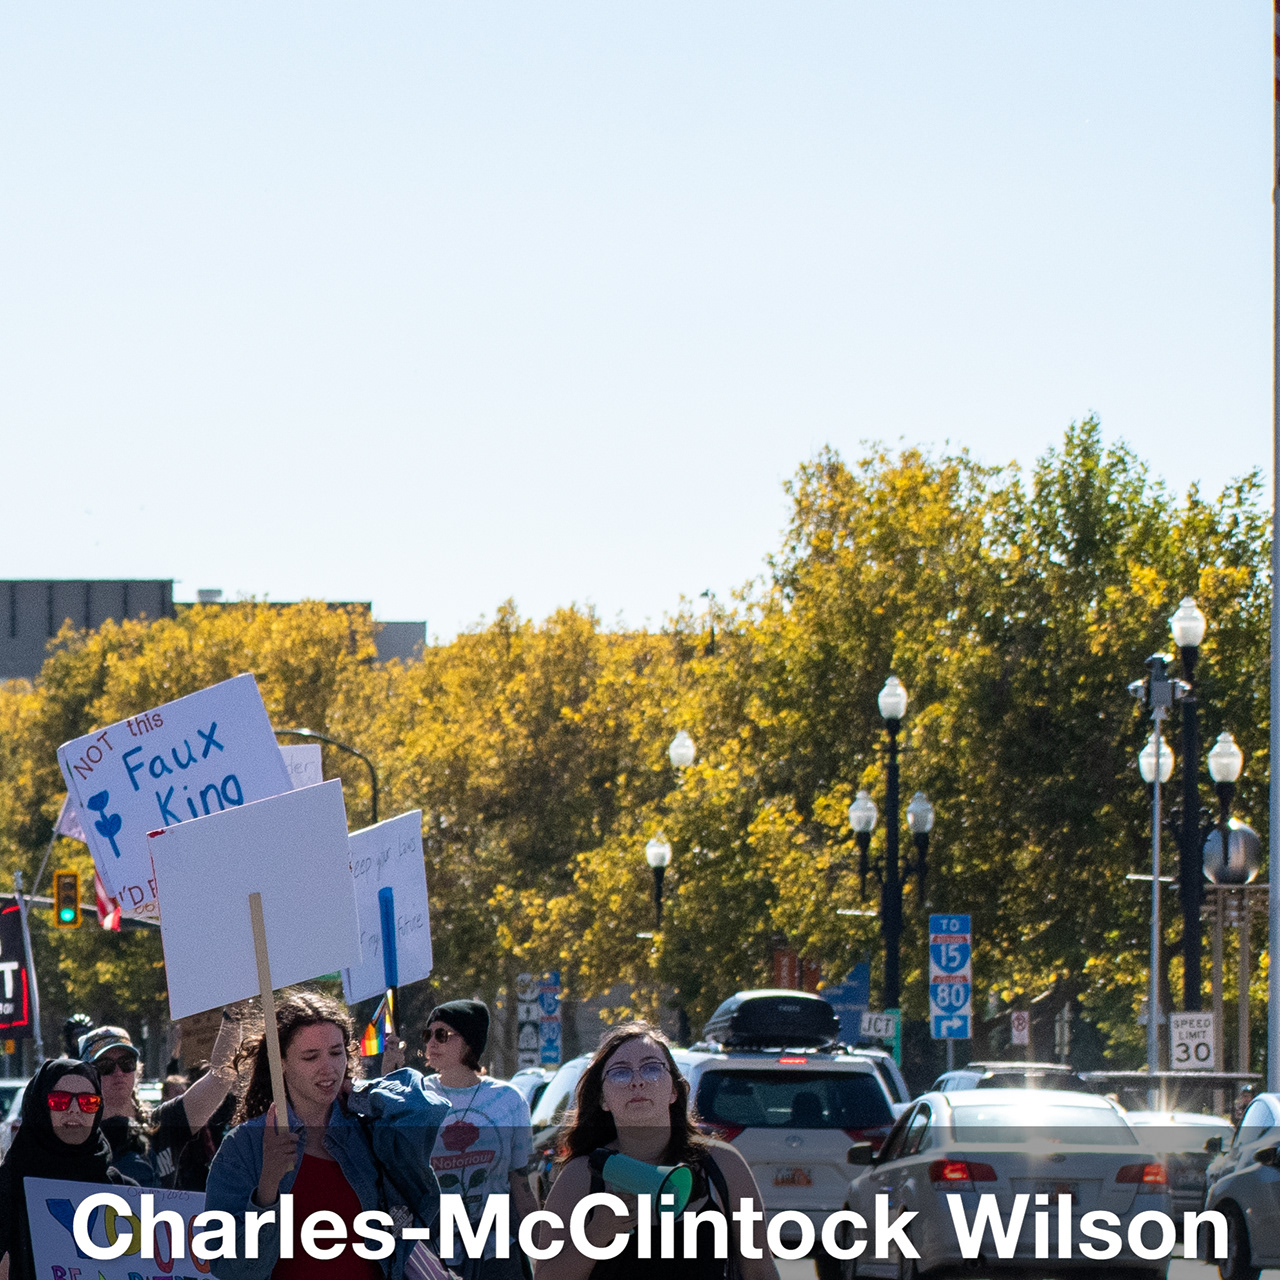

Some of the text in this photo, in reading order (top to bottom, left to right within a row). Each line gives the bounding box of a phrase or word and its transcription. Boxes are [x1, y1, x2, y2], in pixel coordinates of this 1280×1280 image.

[73, 713, 164, 780] NOT this
[122, 721, 224, 791] Faux
[941, 919, 960, 931] TO
[940, 944, 961, 967] 15
[937, 985, 965, 1007] 80
[864, 1018, 891, 1034] JCT
[1173, 1019, 1211, 1029] SPEED
[1179, 1031, 1206, 1039] LIMIT
[1175, 1042, 1211, 1062] 30
